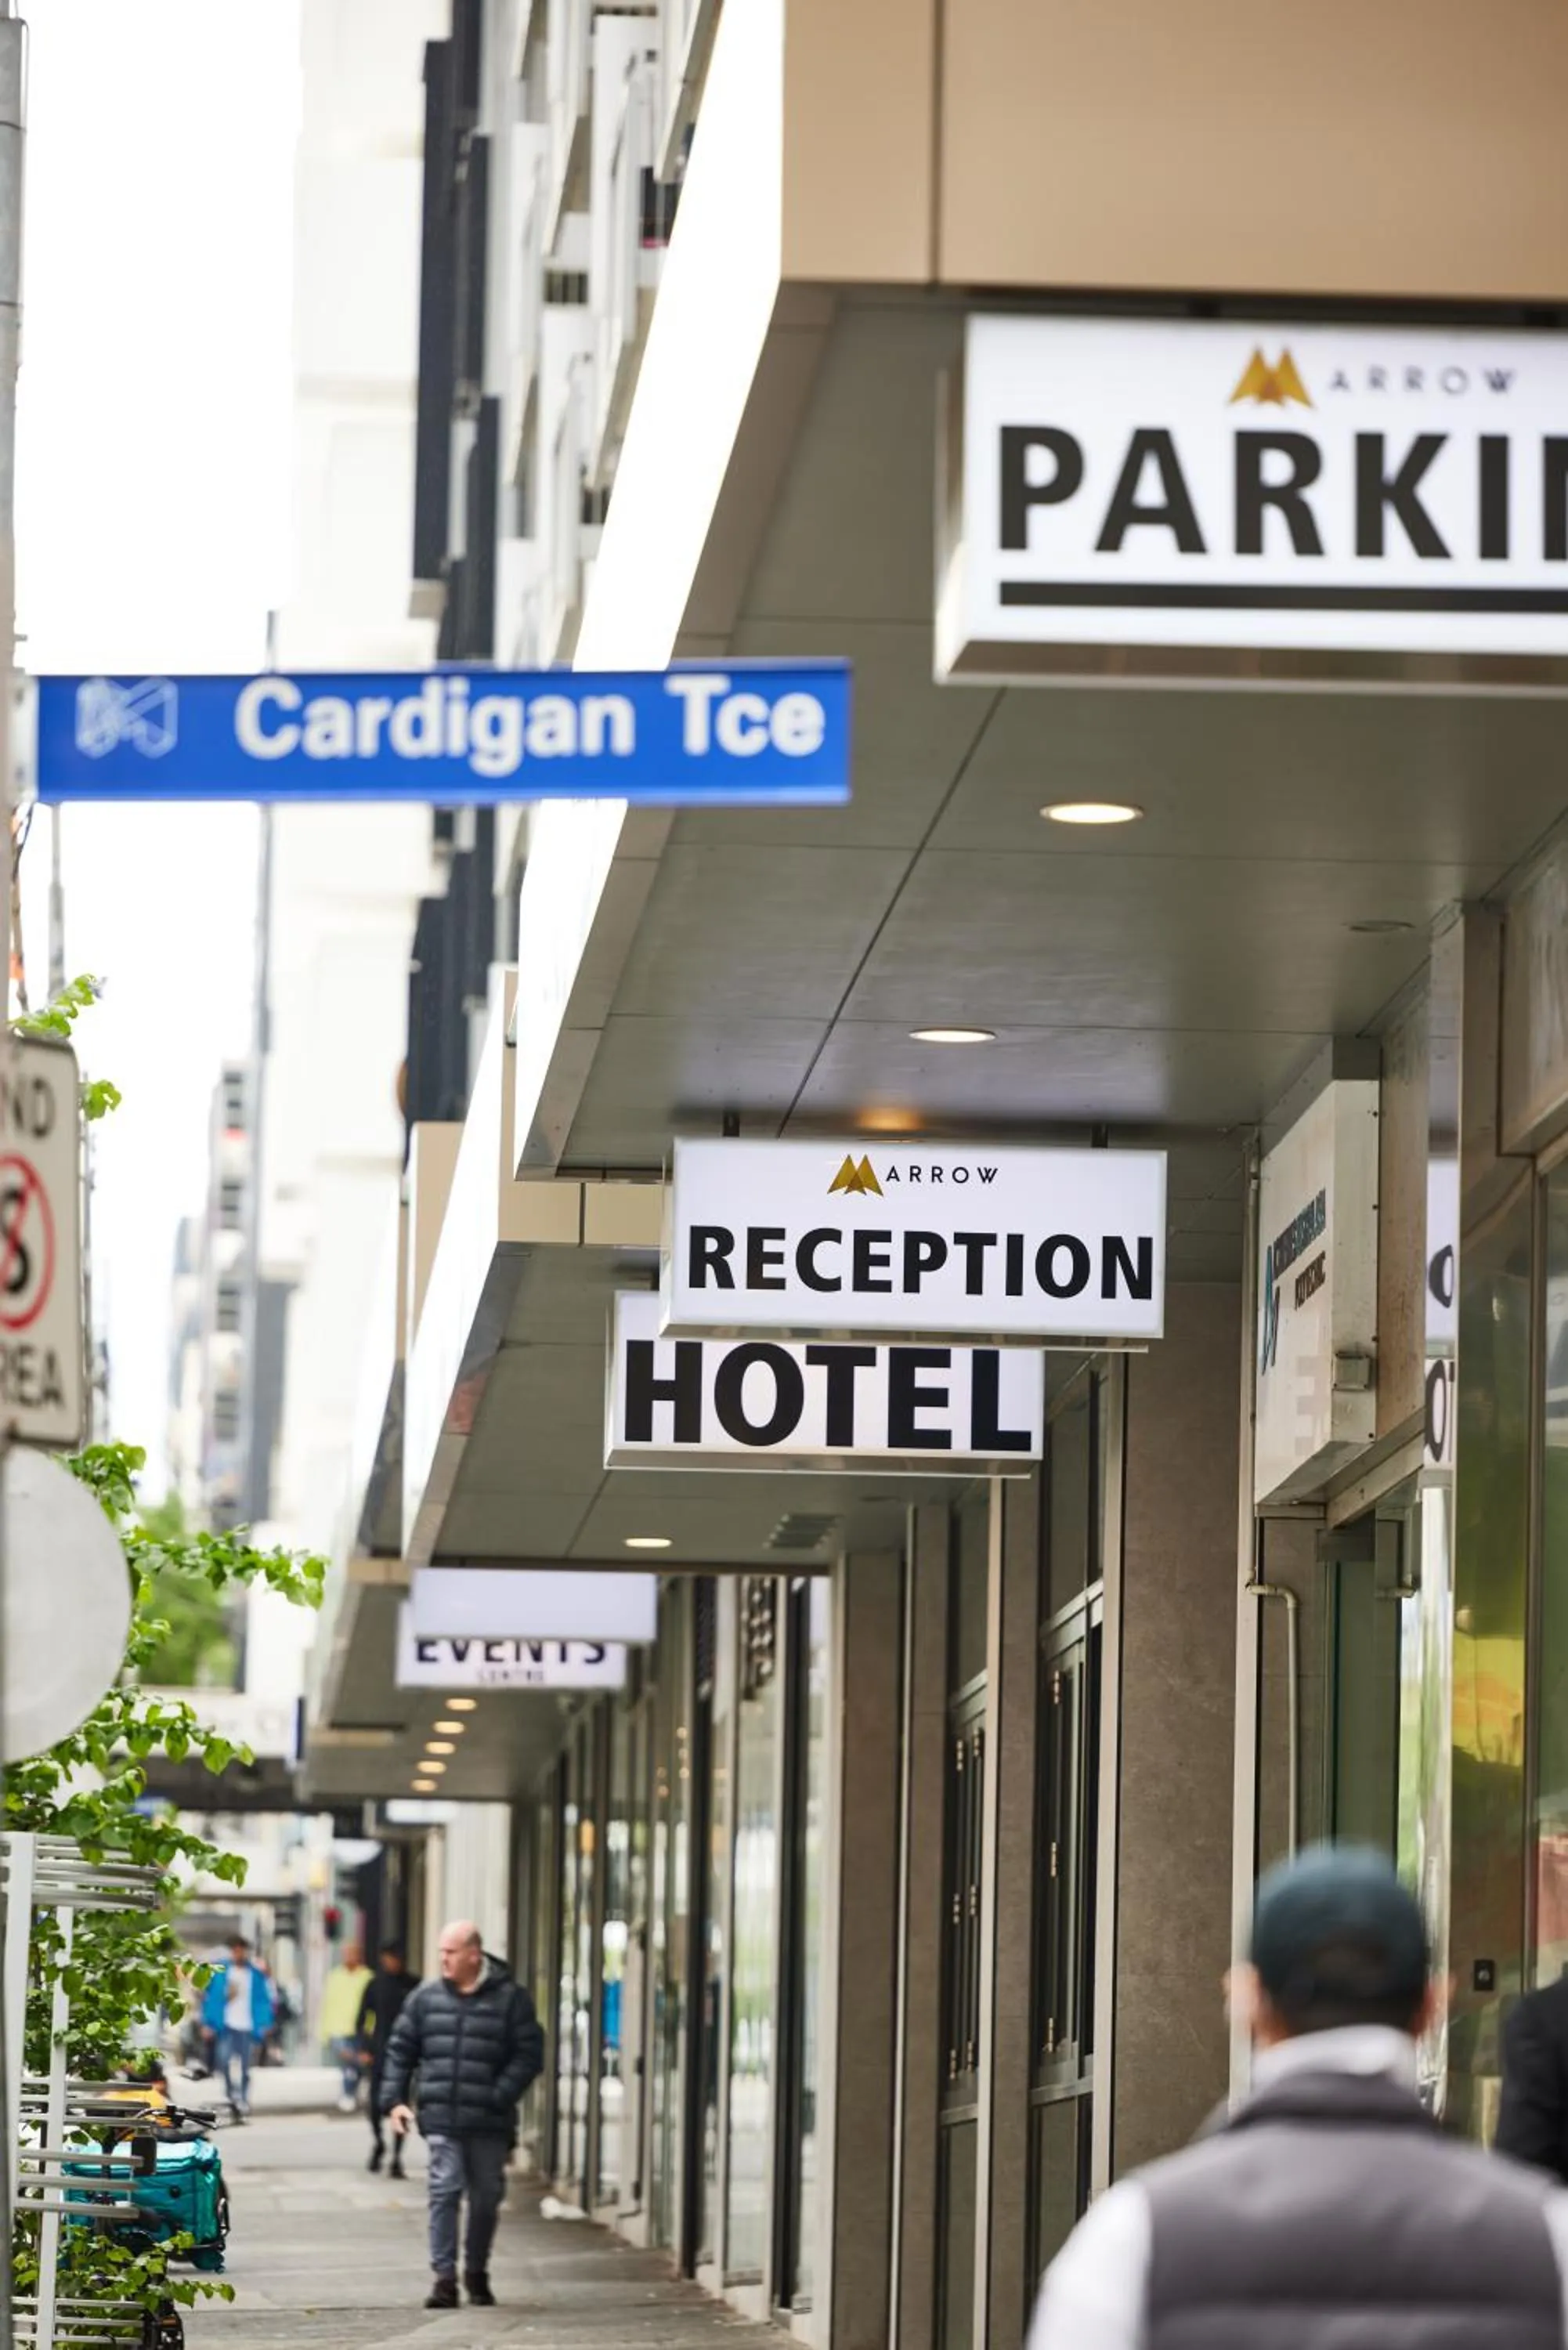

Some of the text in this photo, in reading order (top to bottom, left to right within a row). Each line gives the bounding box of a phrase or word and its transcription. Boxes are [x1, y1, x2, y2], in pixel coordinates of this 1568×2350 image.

[1329, 367, 1516, 394] ARROW
[234, 674, 826, 777] Cardigan Tce
[886, 1165, 999, 1184] ARROW
[688, 1224, 1154, 1300] RECEPTION
[624, 1340, 1032, 1452] HOTEL
